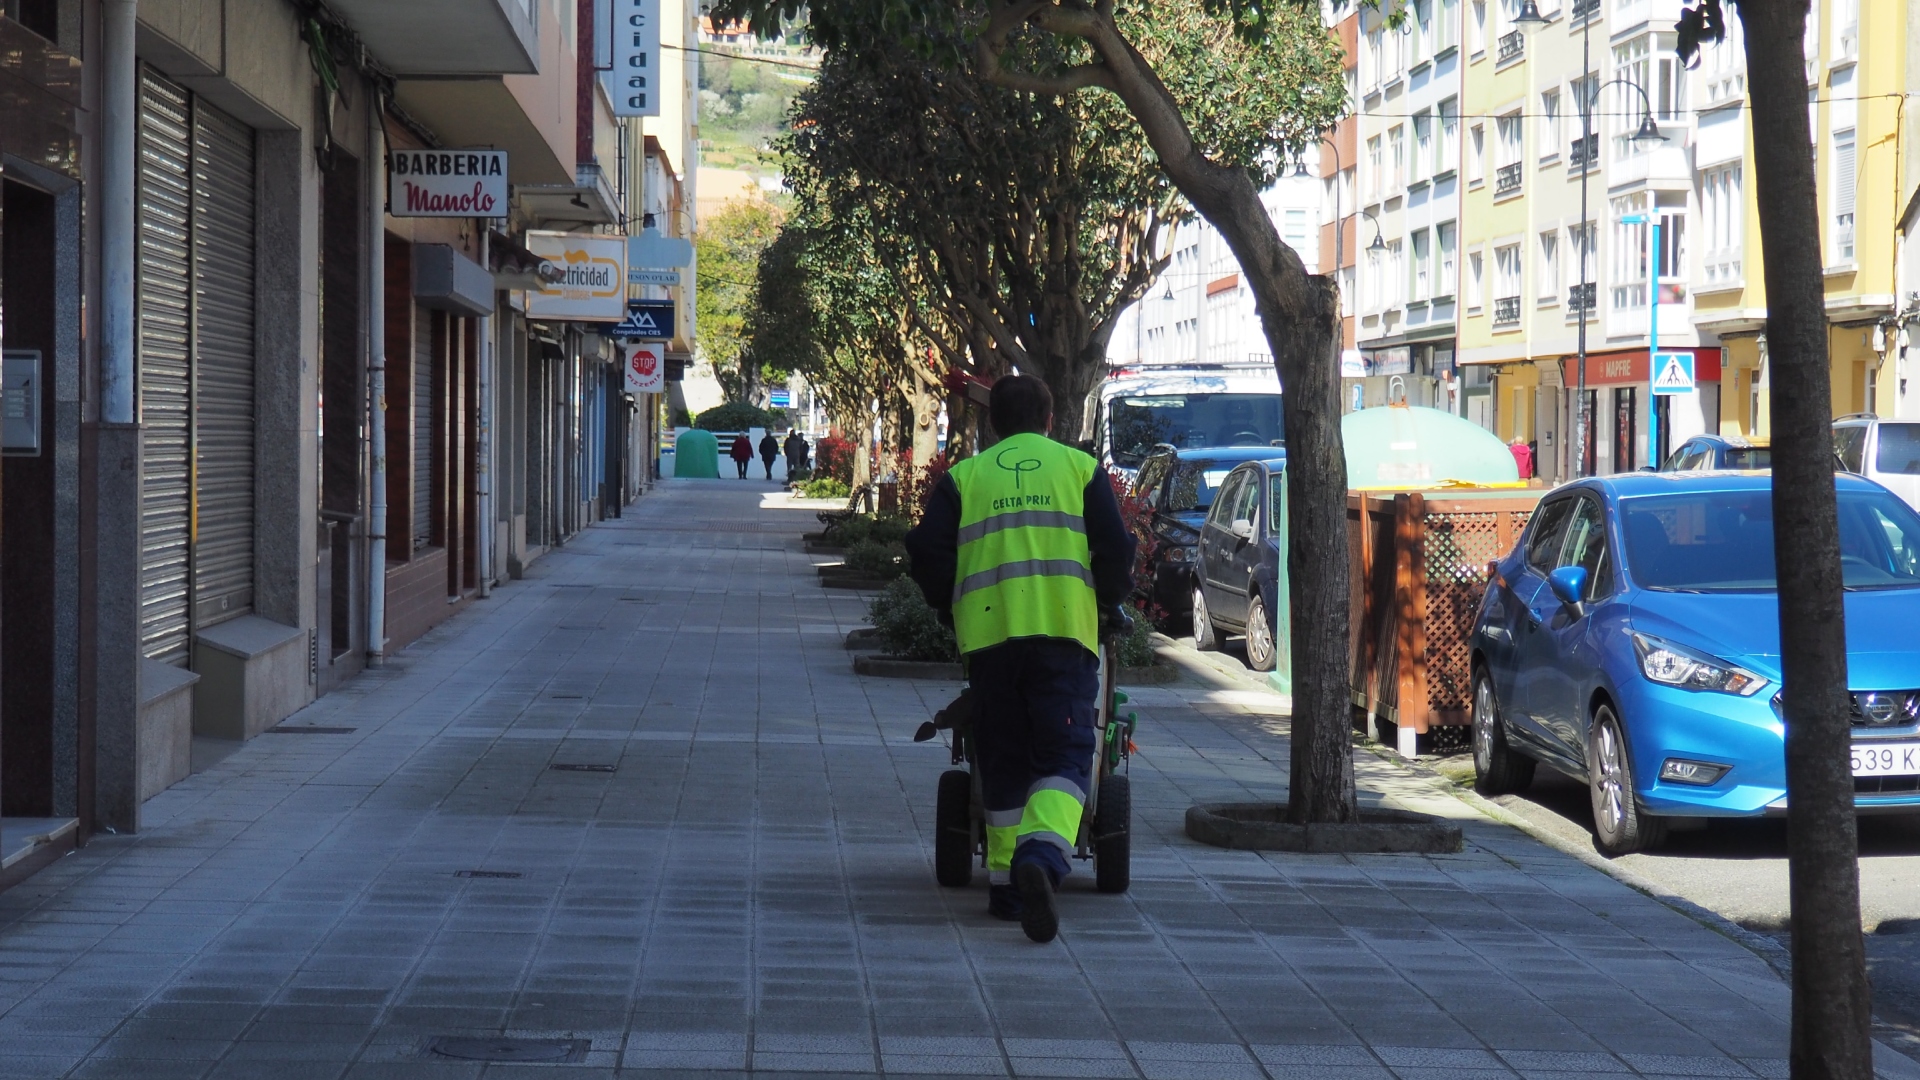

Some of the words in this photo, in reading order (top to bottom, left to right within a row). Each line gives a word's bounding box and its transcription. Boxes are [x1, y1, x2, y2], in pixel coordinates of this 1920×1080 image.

[396, 153, 502, 176] BARBERIA
[404, 181, 496, 212] Manolo
[550, 266, 608, 286] tricidad
[633, 357, 655, 369] STOP
[1606, 359, 1631, 378] MAPFRE
[627, 374, 661, 387] PIZZERIA
[993, 497, 1022, 510] CELTA
[1026, 495, 1051, 505] PRIX
[1903, 748, 1920, 770] K
